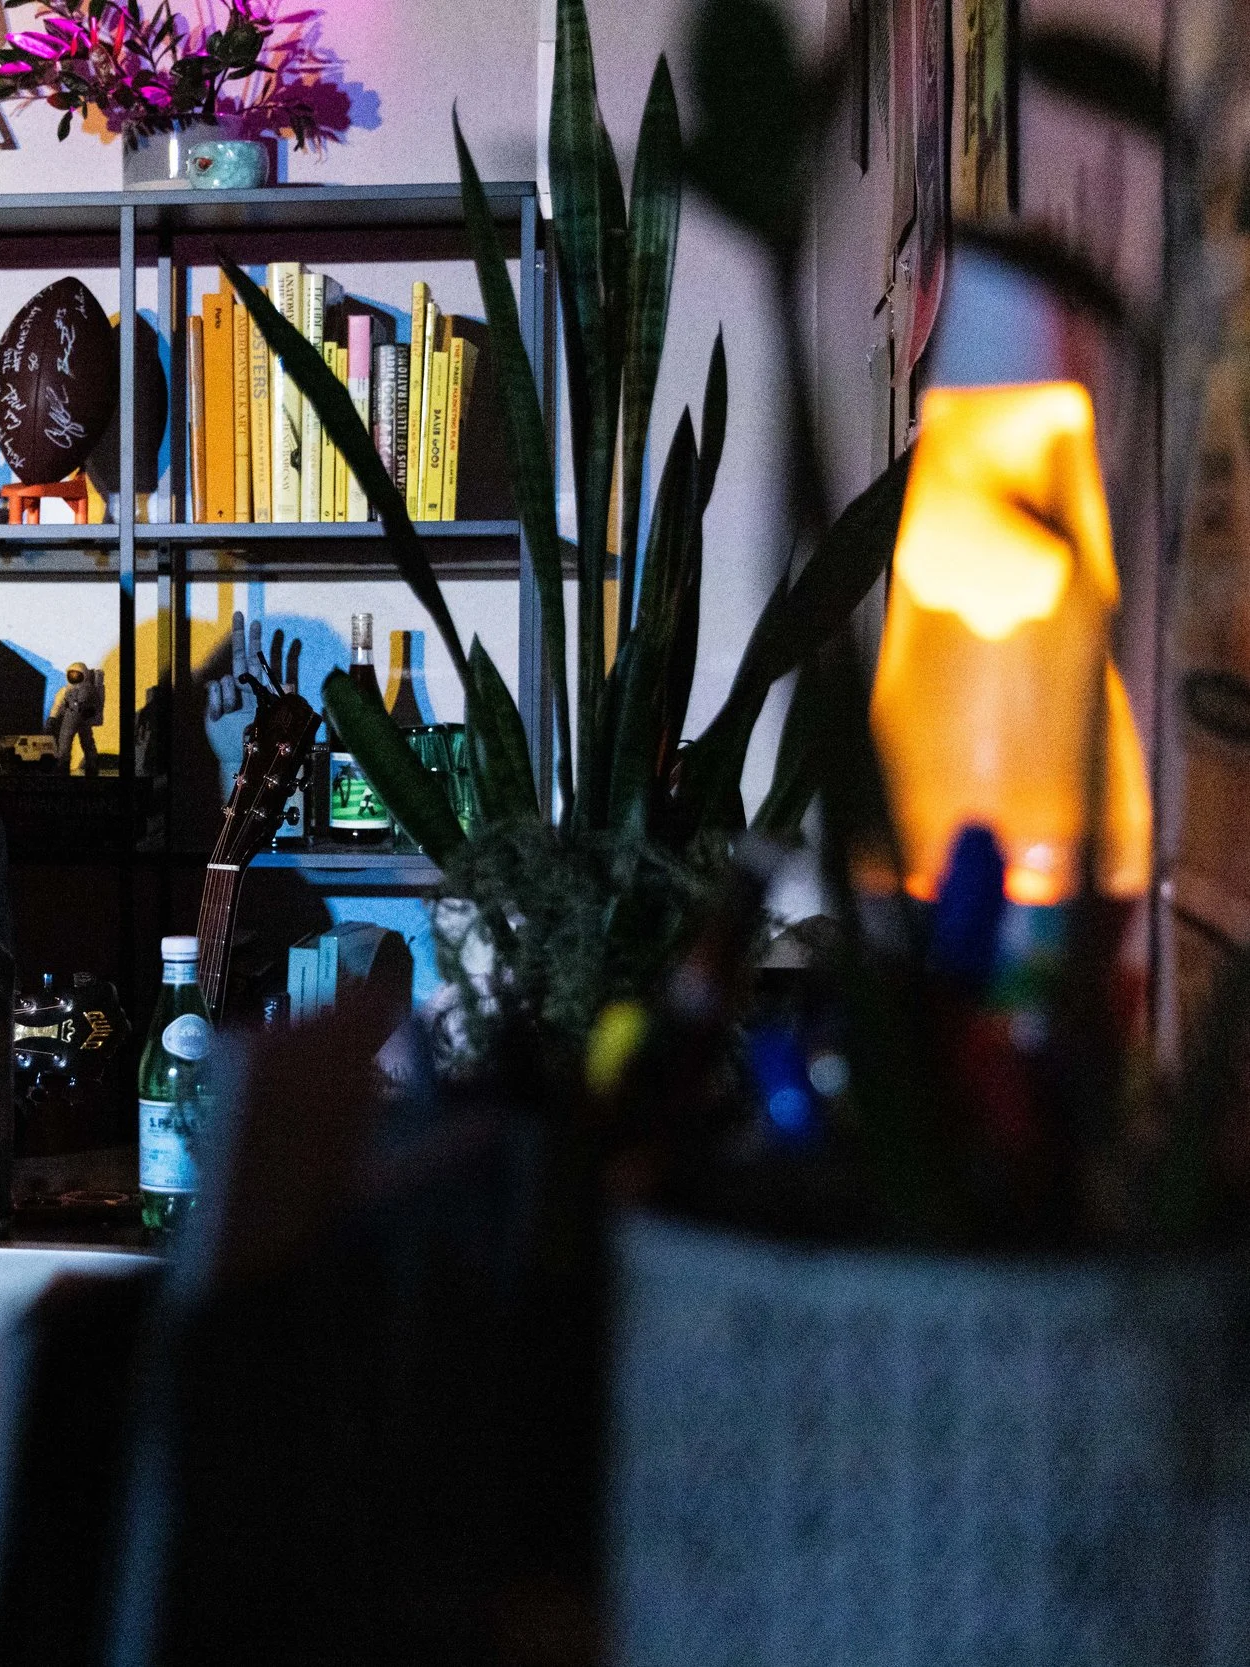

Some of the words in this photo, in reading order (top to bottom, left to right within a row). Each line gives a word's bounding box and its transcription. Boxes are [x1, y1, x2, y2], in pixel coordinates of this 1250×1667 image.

[237, 315, 248, 377] AMERICAN
[252, 327, 268, 400] OSTERS
[237, 379, 247, 410] FOLK
[79, 1010, 114, 1050] GUILD
